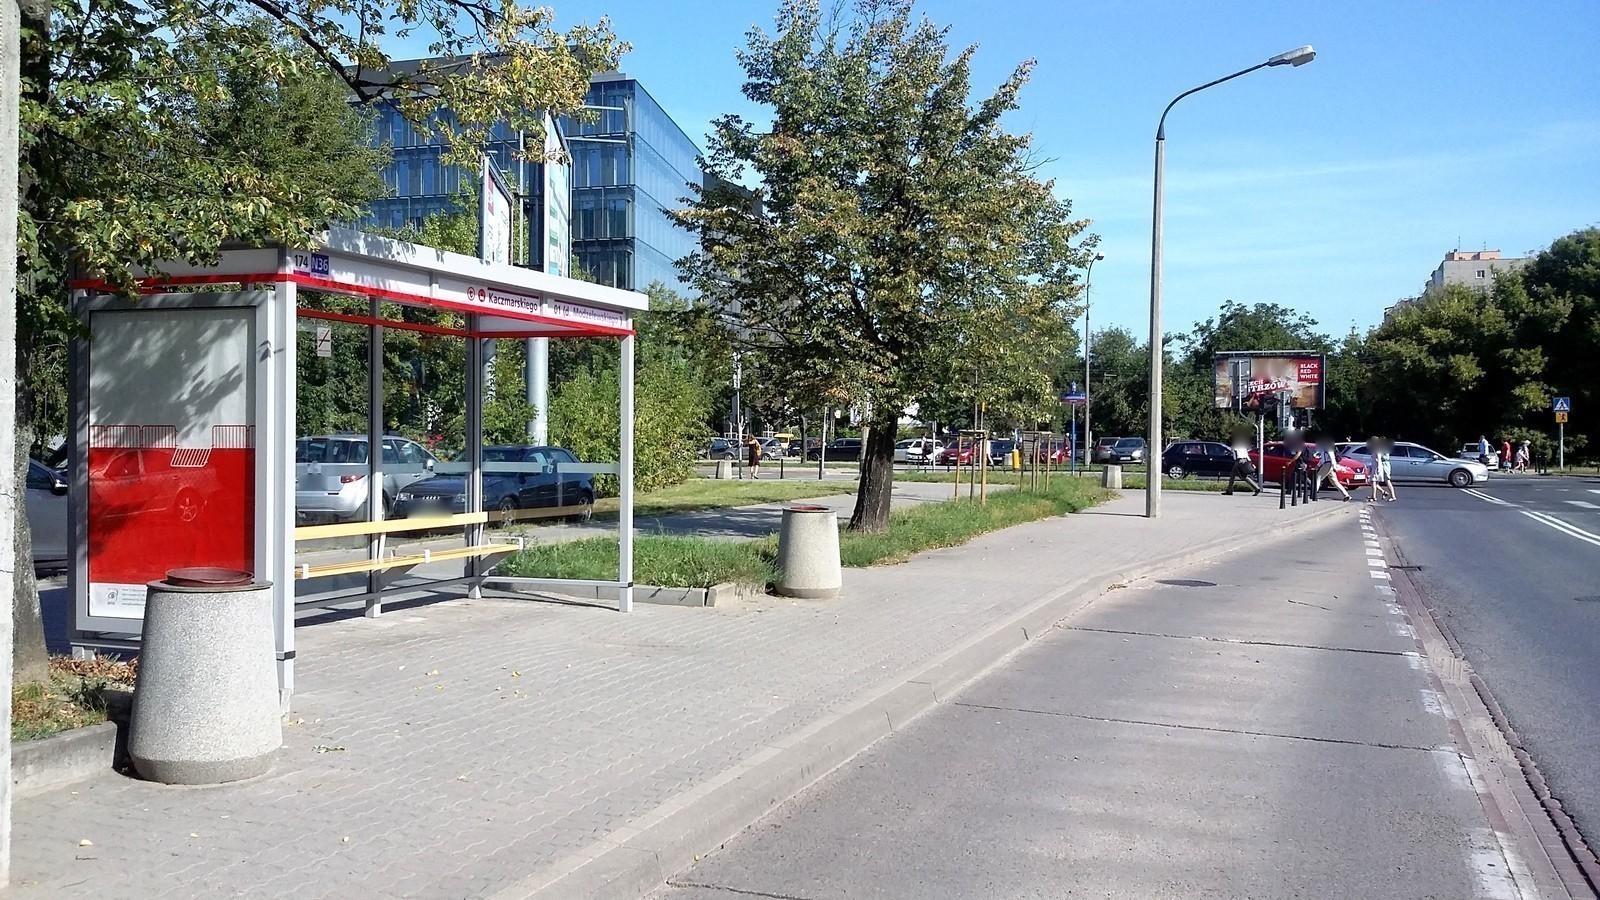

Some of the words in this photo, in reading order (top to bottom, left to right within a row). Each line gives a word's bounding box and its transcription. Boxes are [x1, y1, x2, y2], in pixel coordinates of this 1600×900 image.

[294, 254, 308, 268] 174
[311, 256, 329, 271] N36
[488, 292, 539, 313] Kaczmarskiego
[554, 304, 561, 315] 01
